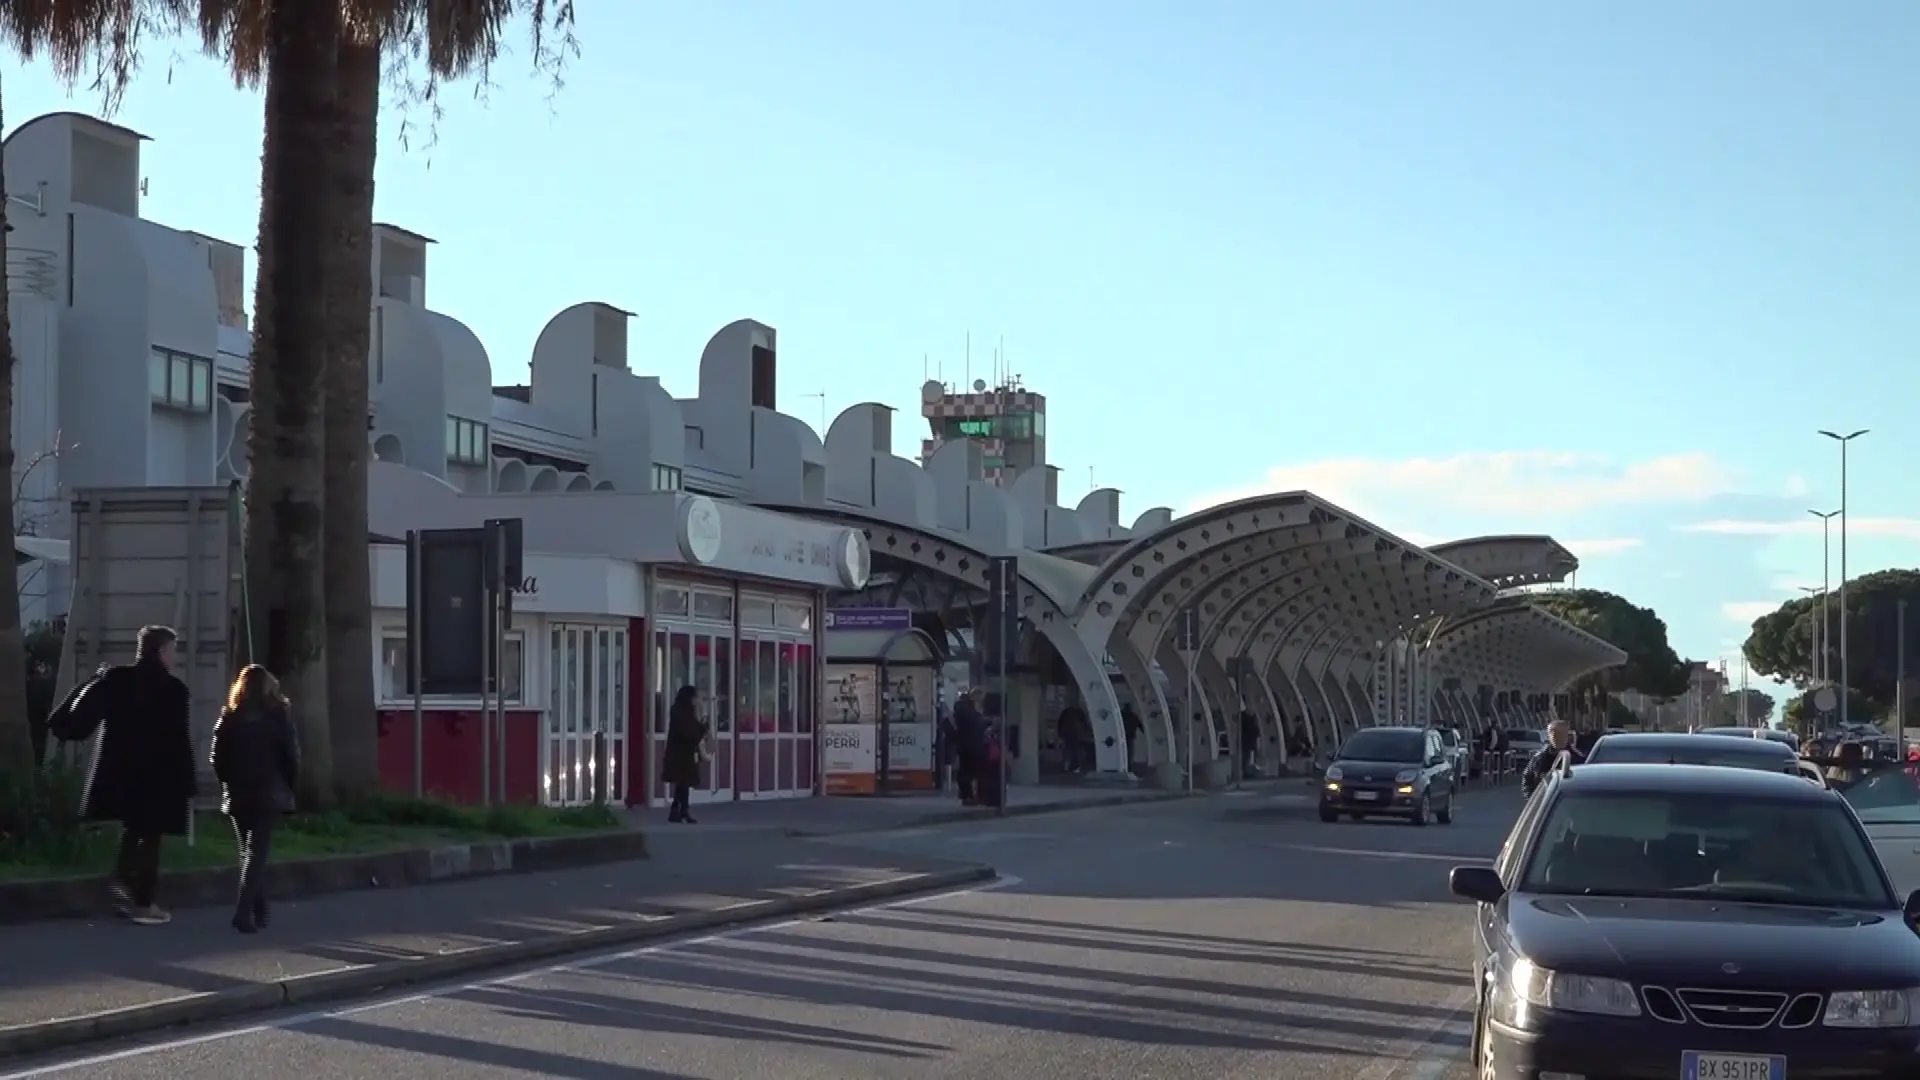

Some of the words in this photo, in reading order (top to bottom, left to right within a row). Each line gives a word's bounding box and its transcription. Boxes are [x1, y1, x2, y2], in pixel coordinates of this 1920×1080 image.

[825, 736, 860, 749] PERRI
[888, 735, 917, 748] ERRI
[1700, 1059, 1717, 1077] BX
[1722, 1061, 1768, 1080] 951PR
